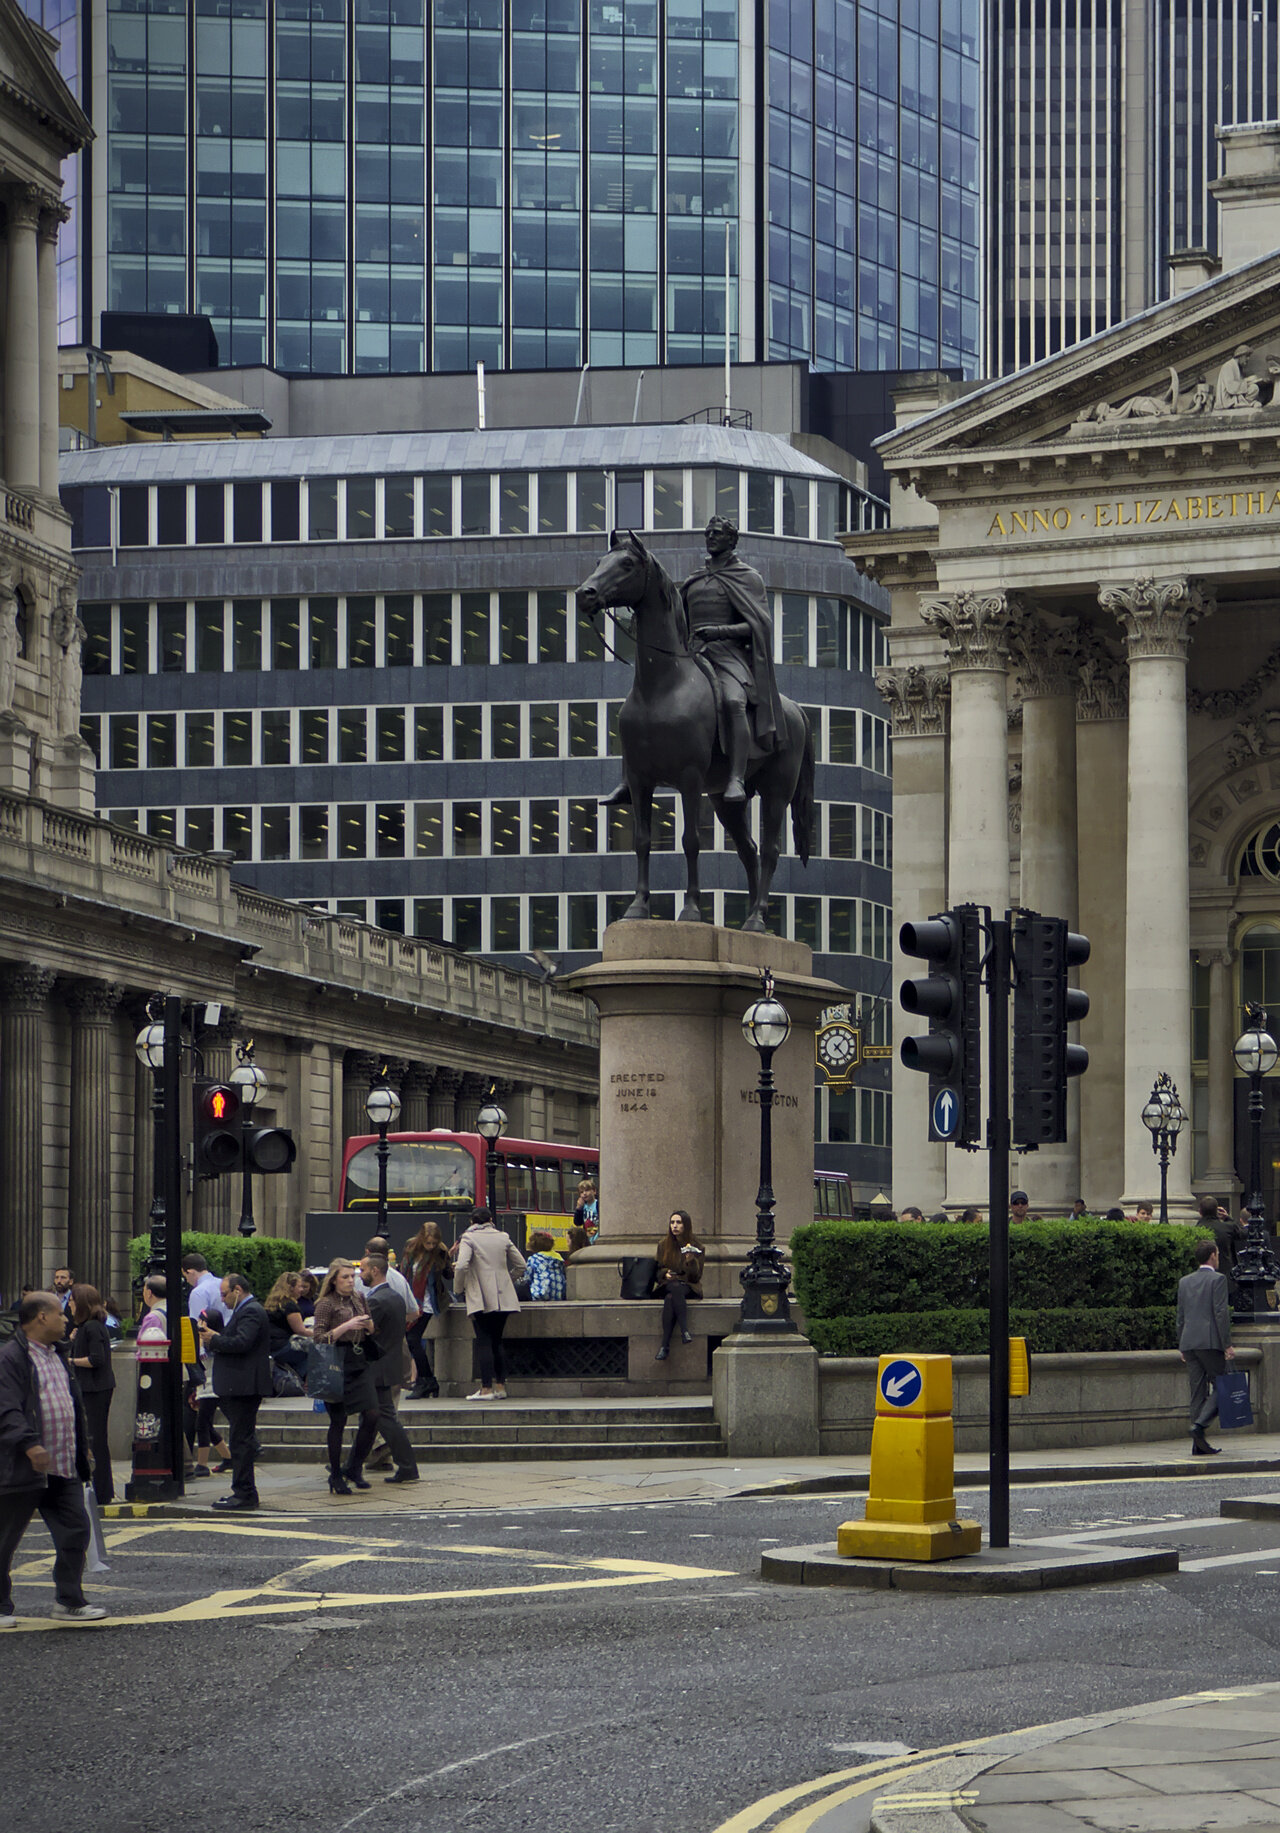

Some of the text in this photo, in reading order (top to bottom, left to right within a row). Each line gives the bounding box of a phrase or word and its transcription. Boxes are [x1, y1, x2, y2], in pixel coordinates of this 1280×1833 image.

[986, 507, 1072, 537] ANNO
[610, 1073, 665, 1083] ERECTED
[616, 1088, 656, 1097] JUNE 18
[740, 1089, 798, 1108] WELGTON
[620, 1103, 648, 1112] 1844
